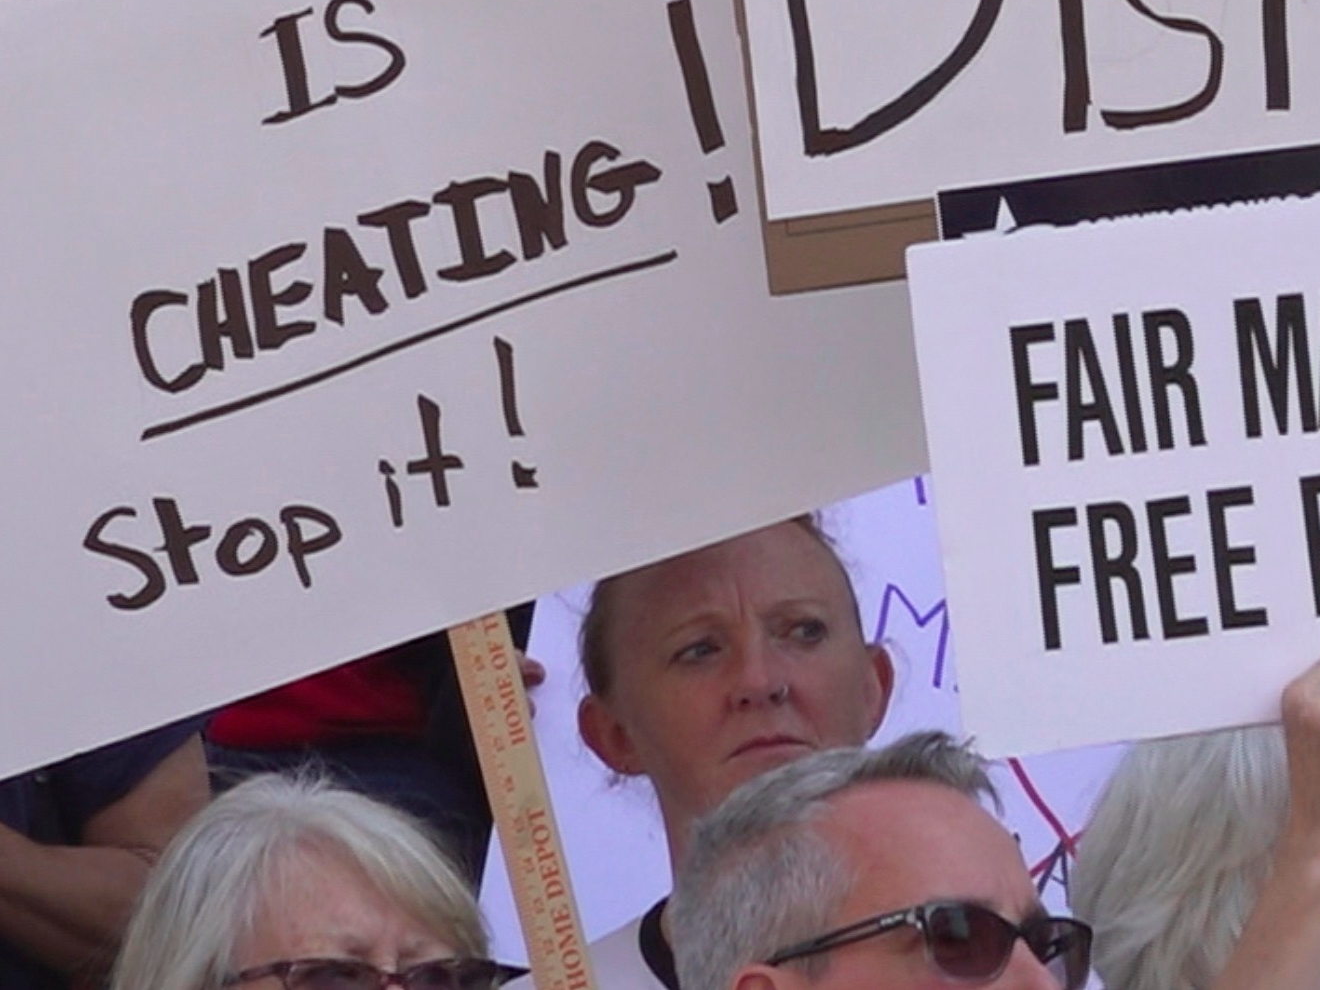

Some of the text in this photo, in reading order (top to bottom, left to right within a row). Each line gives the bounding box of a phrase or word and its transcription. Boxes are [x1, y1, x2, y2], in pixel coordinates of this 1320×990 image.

[1008, 306, 1206, 467] FAIR
[83, 497, 342, 610] Stop
[1032, 485, 1268, 652] FREE
[496, 676, 527, 746] HOME
[527, 807, 588, 990] HOME DEPOT
